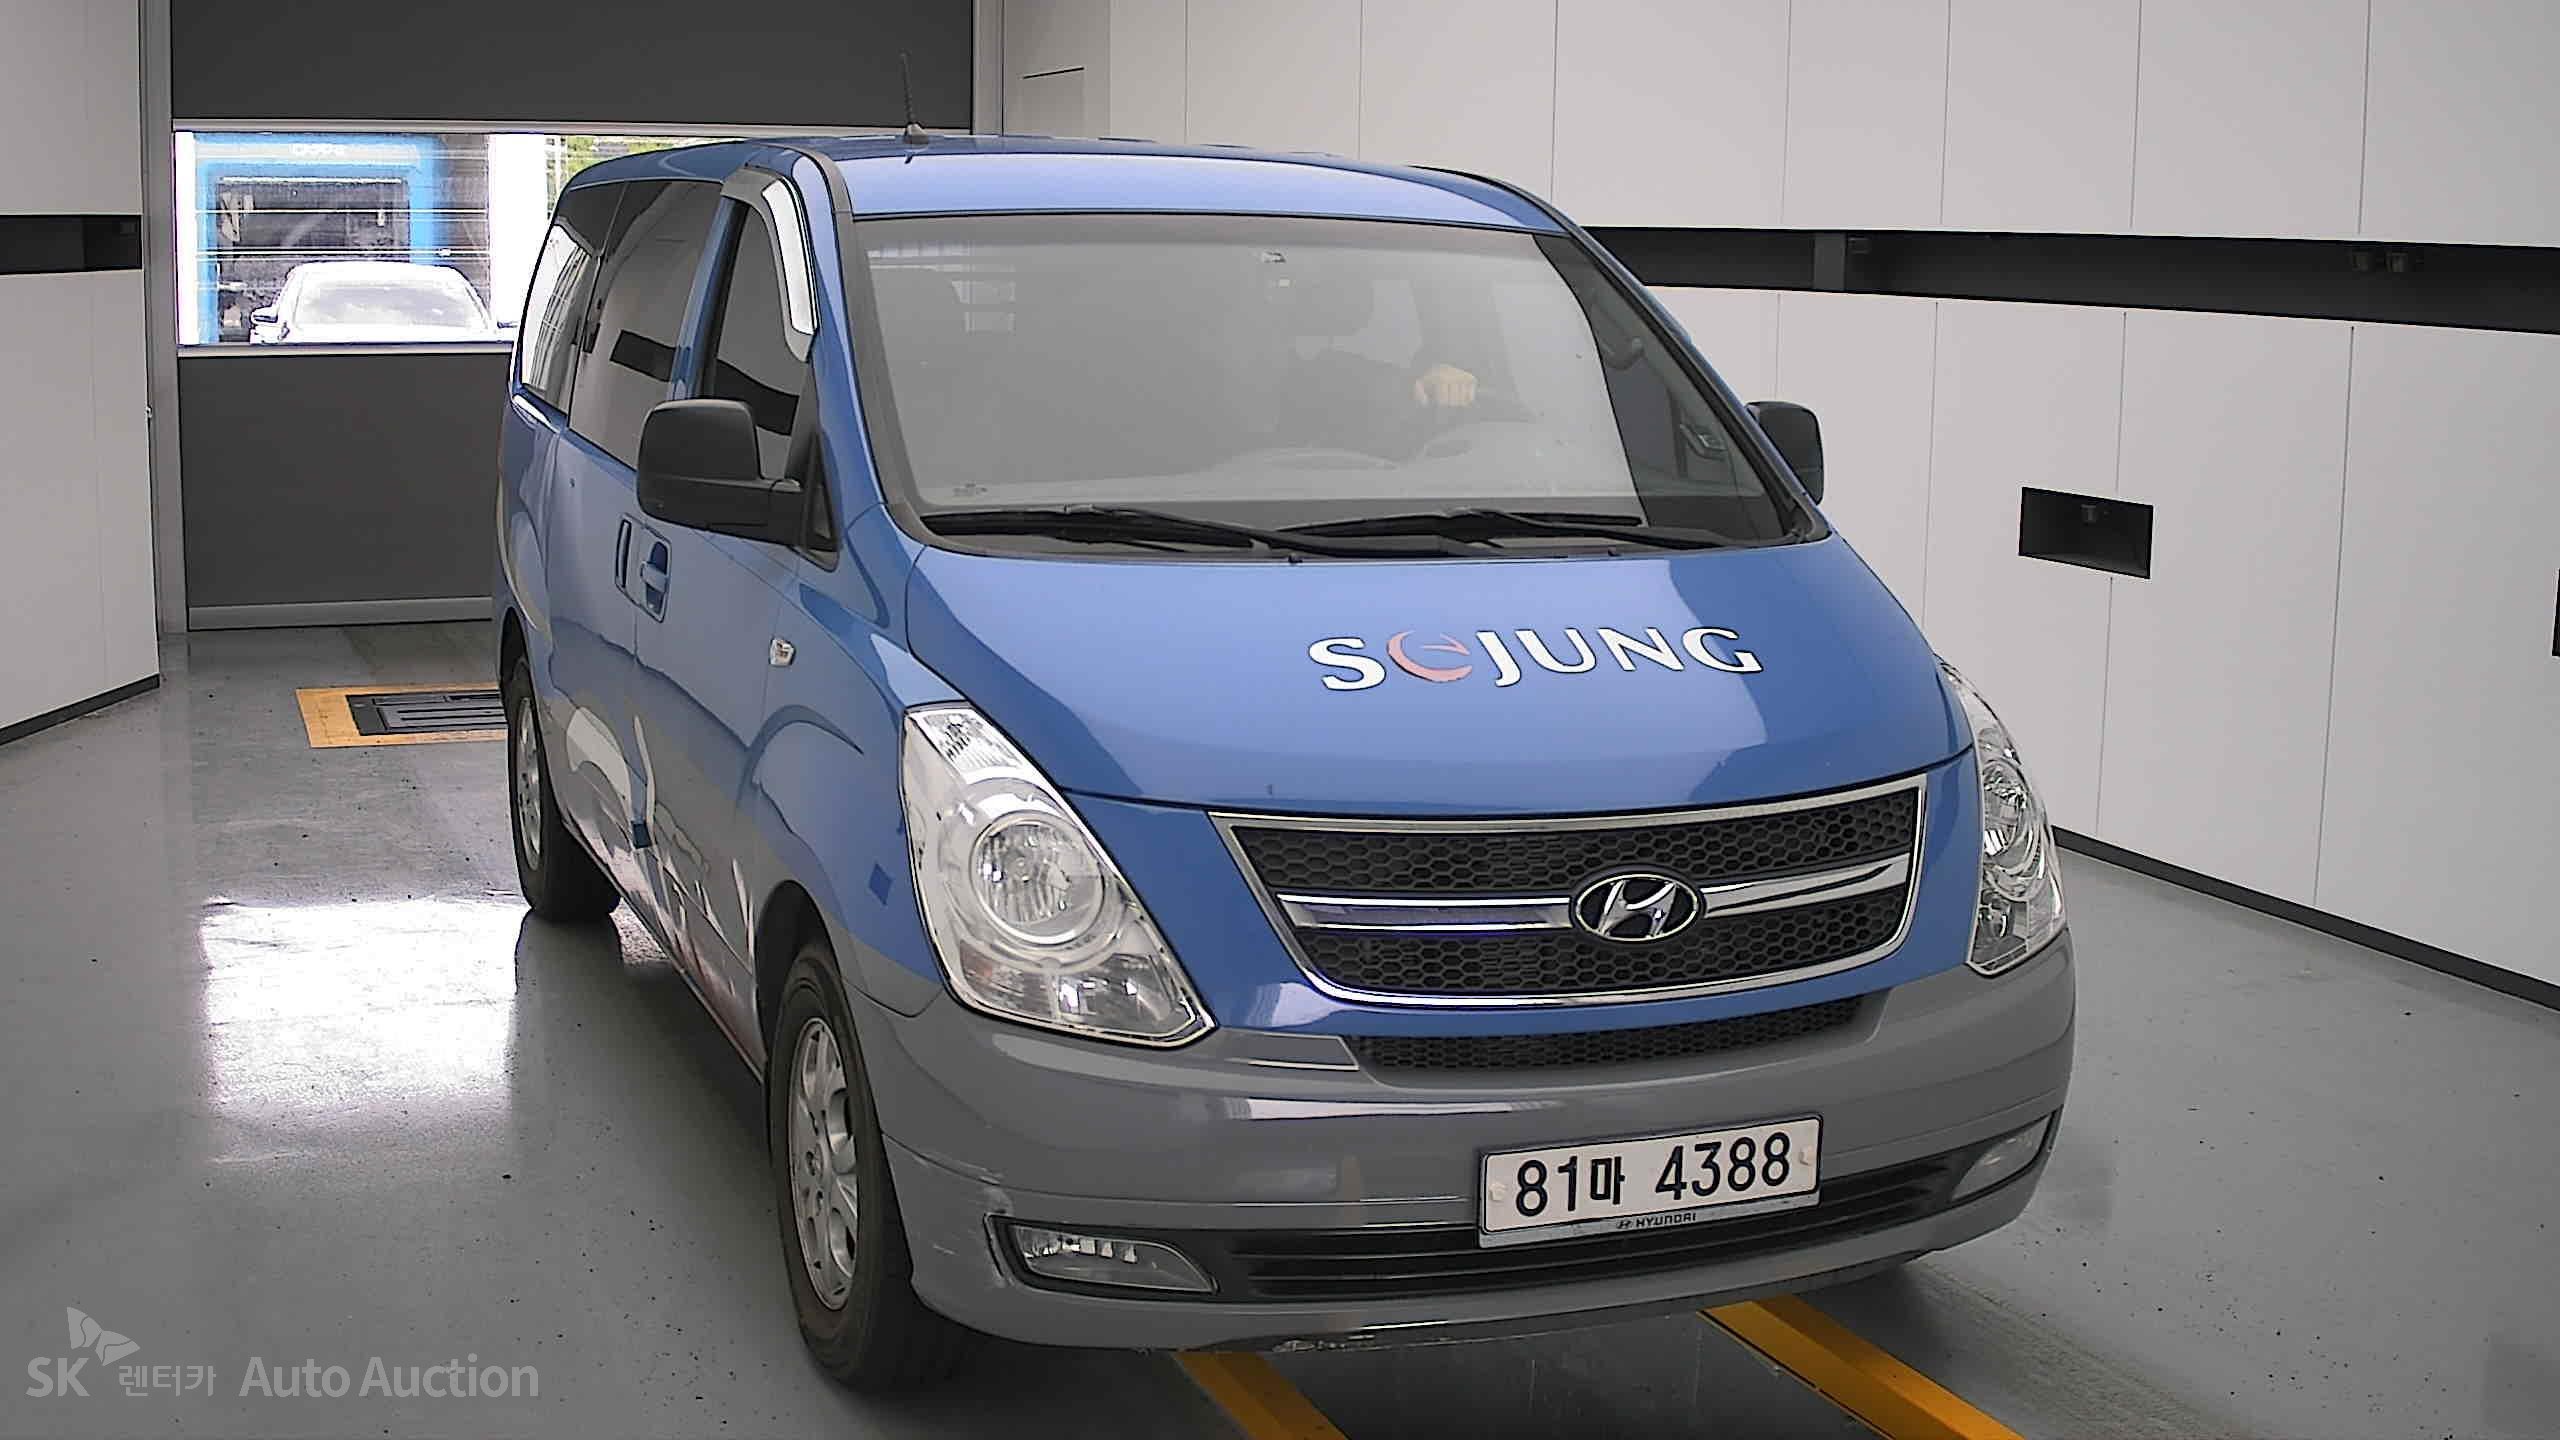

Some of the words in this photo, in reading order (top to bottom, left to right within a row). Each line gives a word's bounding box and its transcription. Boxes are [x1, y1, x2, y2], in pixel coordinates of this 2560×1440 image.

[1515, 1155, 1626, 1218] 81마
[1654, 1132, 1791, 1201] 4388
[1636, 1212, 1697, 1228] HYUNDAI
